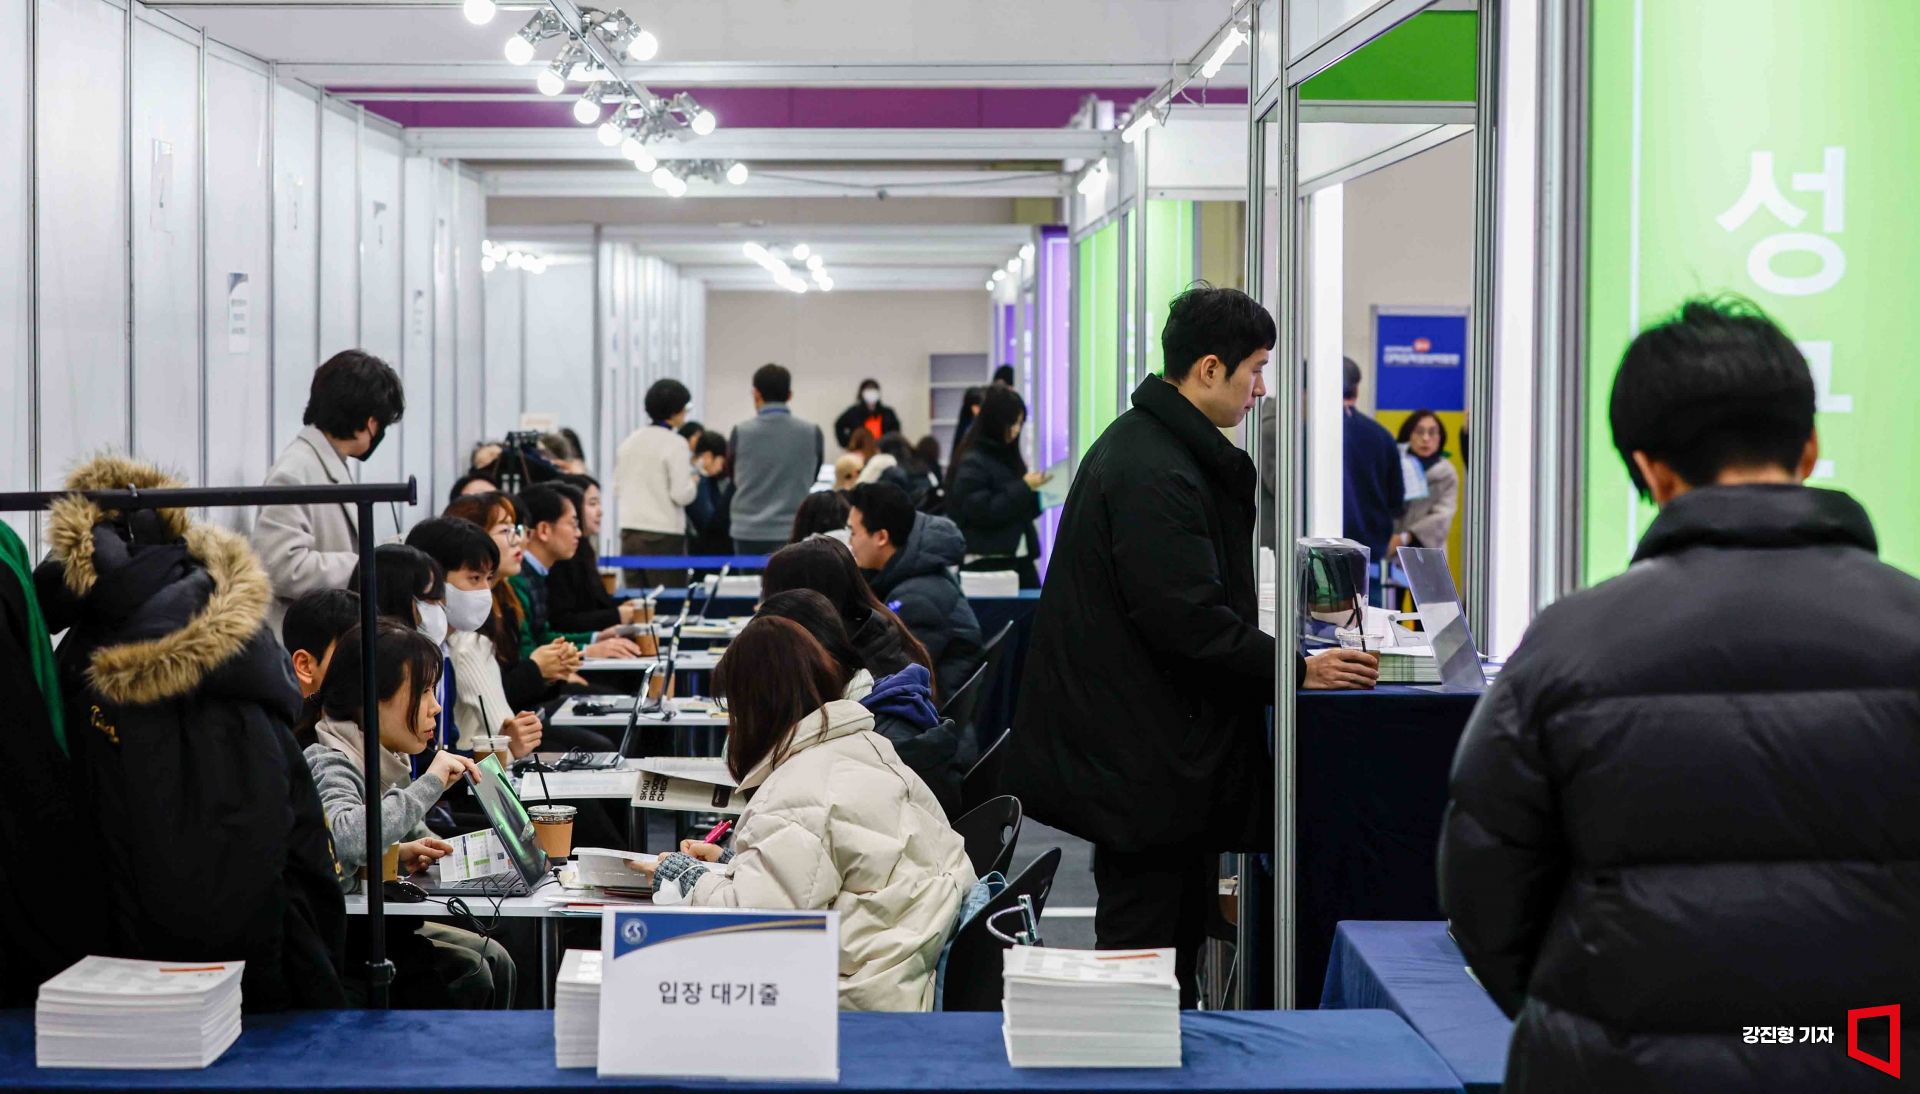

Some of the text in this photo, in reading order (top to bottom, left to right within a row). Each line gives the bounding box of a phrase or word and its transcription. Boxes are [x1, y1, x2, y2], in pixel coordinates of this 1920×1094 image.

[640, 780, 650, 801] SKKU
[659, 981, 780, 1007] 입장 대기줄
